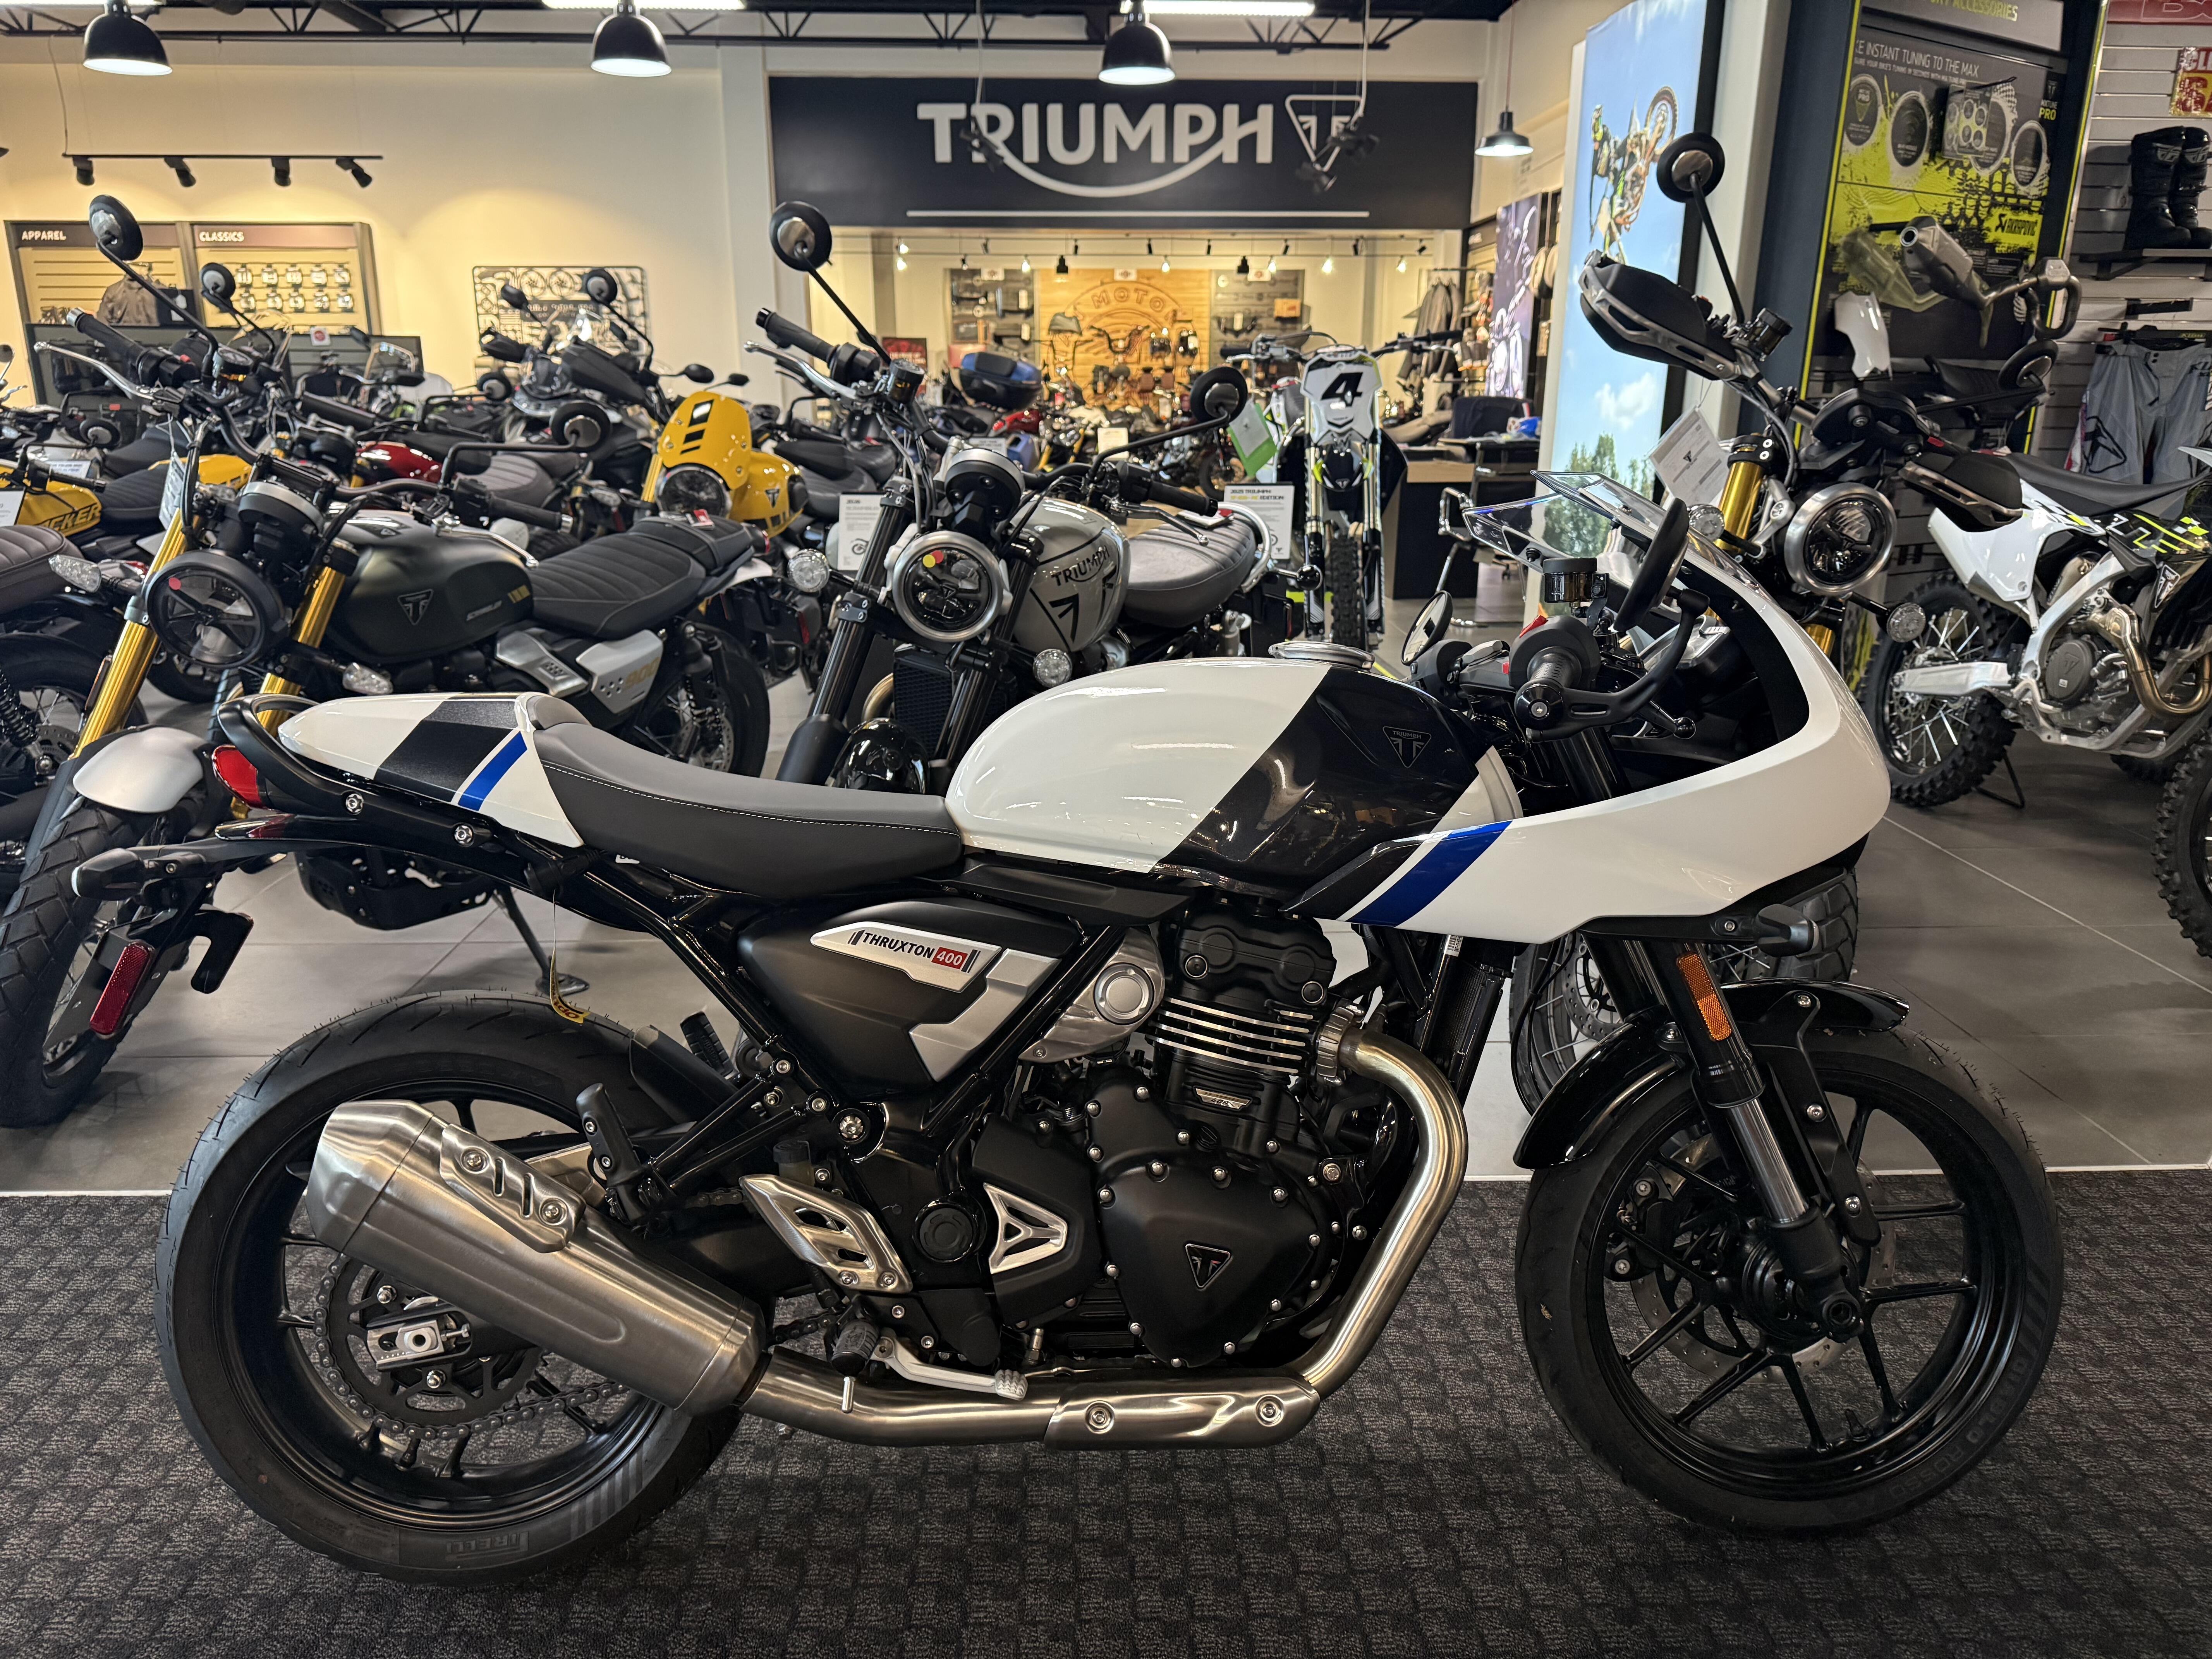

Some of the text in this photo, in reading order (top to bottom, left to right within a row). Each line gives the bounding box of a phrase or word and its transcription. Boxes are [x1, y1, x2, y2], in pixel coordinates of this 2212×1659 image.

[1866, 42, 1900, 61] INSTANT
[1902, 49, 1930, 68] TUNING
[1933, 56, 1943, 70] TO
[1946, 58, 1960, 74] THE
[1961, 62, 1979, 77] MAX
[2039, 107, 2056, 120] PRO
[917, 103, 1274, 197] TRIUMPH
[22, 231, 66, 240] APPAREL
[199, 231, 244, 242] CLASSICS
[1321, 372, 1363, 407] 4
[1051, 545, 1110, 586] TRIUMPH
[1392, 730, 1421, 739] TRIUMPH
[862, 932, 963, 966] THRUXTON 400
[446, 1531, 529, 1562] PIRELLI
